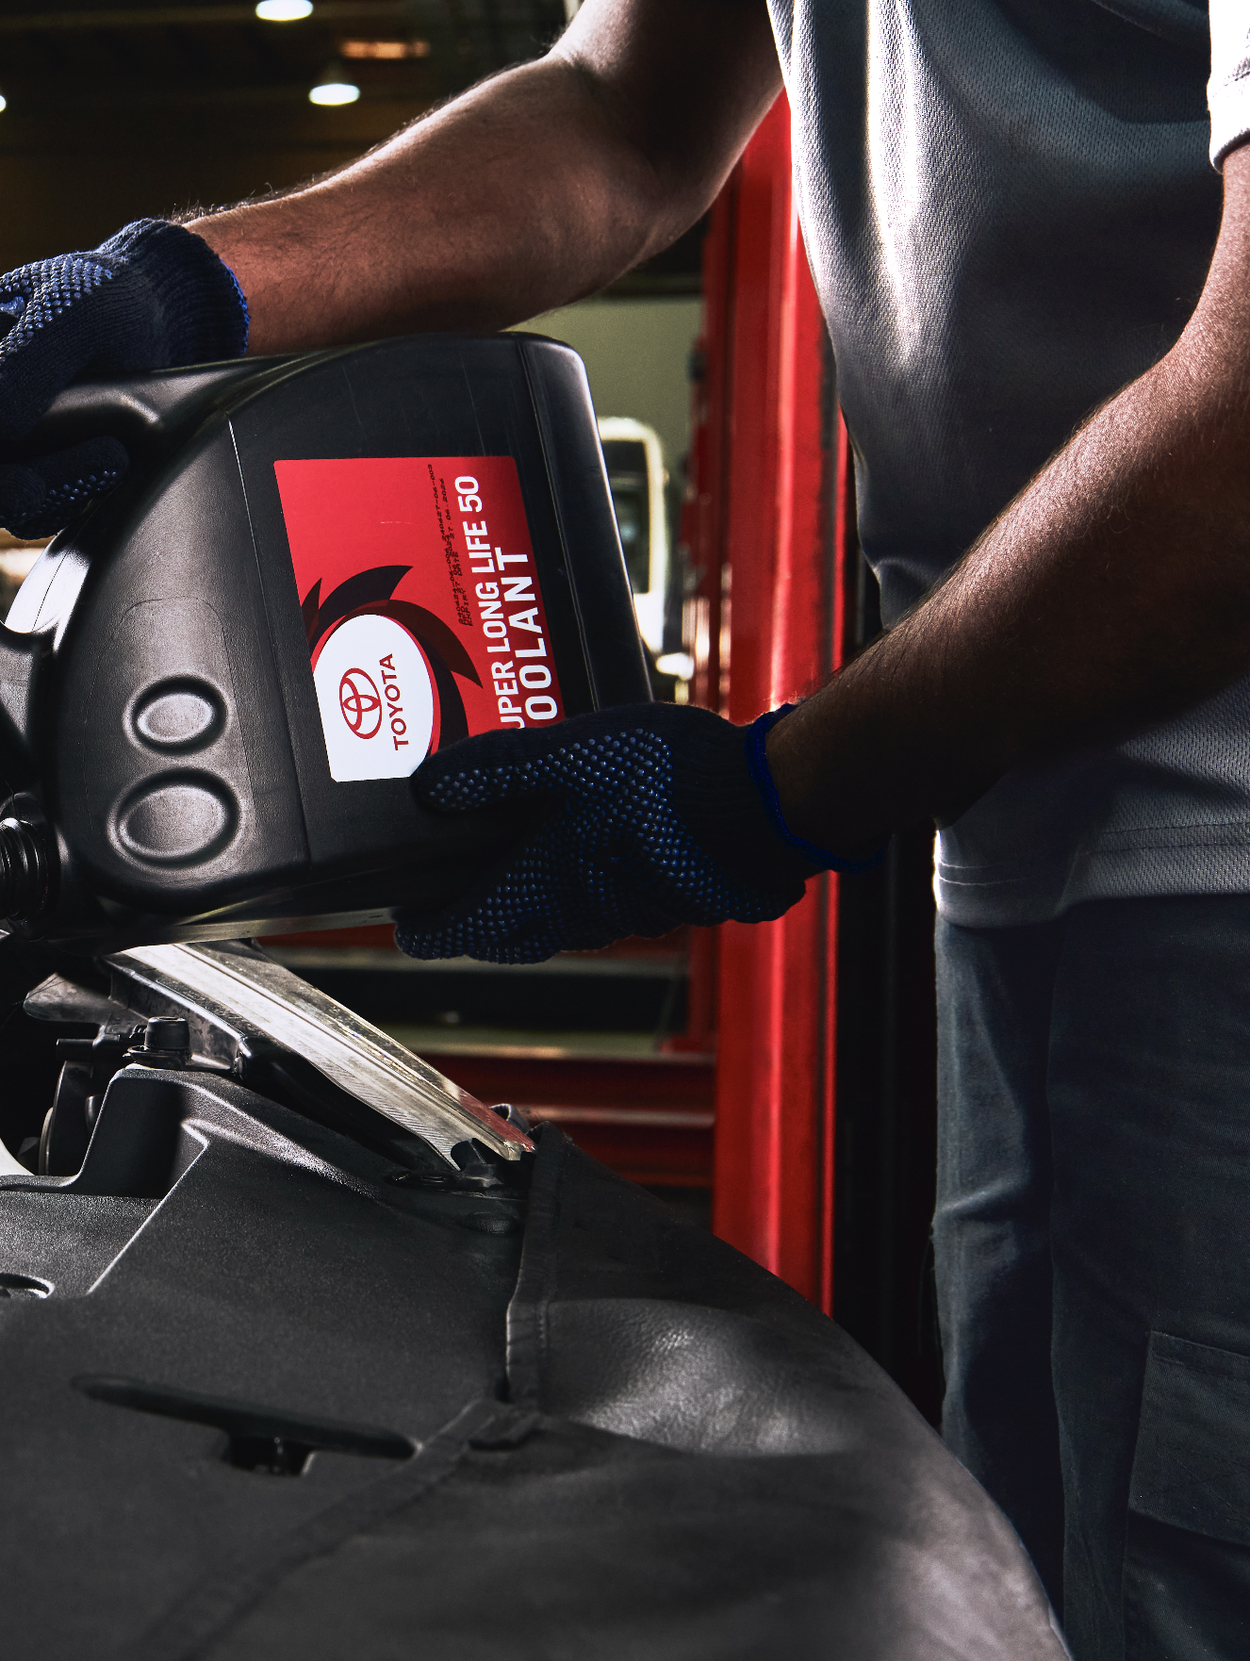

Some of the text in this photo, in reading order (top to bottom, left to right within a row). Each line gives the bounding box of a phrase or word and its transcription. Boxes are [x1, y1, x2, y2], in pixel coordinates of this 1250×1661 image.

[454, 475, 524, 729] UPER LONG LIFE 50
[494, 547, 558, 721] OOLANT
[379, 653, 409, 751] TOYOTA
